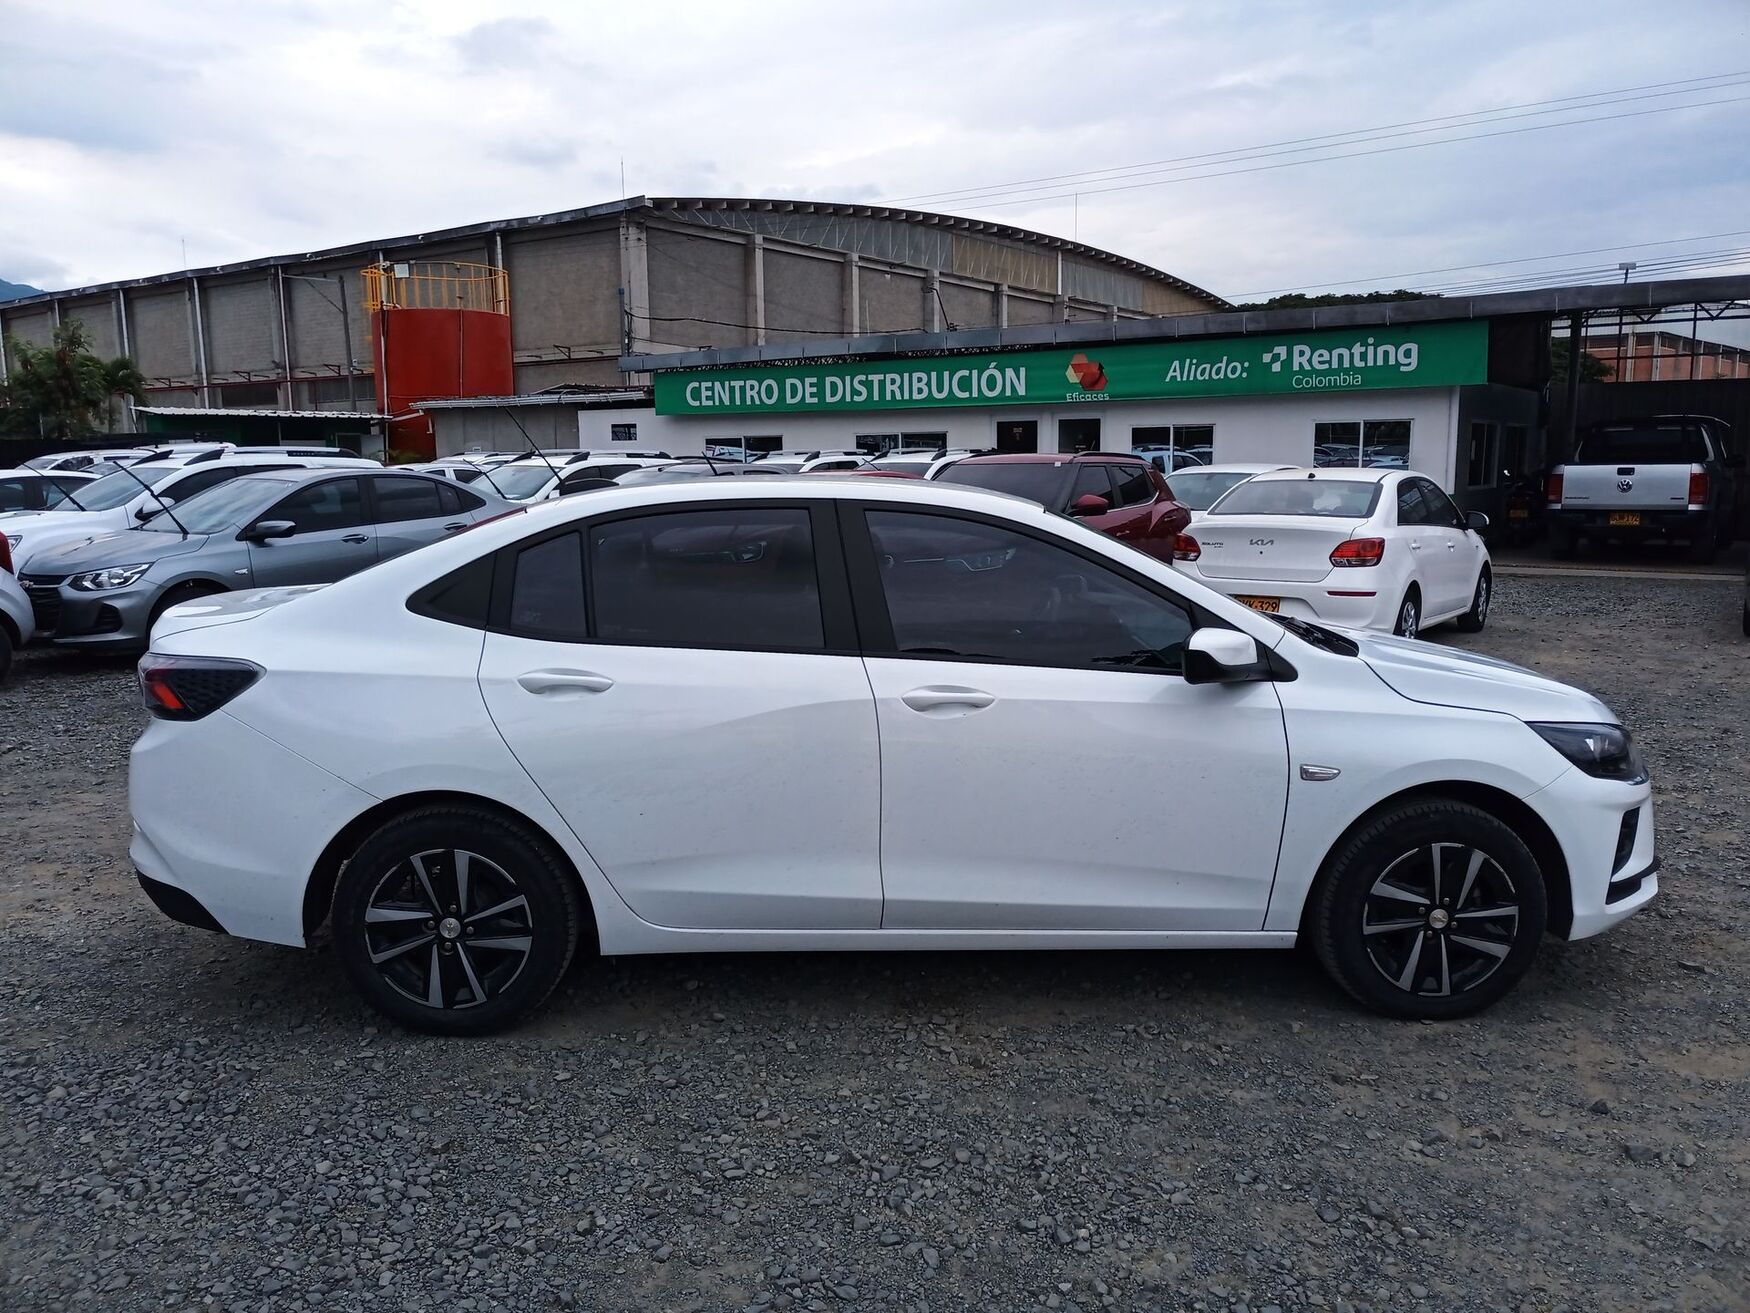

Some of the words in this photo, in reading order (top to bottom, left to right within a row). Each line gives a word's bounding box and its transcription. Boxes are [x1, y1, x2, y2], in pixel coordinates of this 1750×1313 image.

[1292, 337, 1419, 372] Renting
[1165, 356, 1250, 382] Aliado:
[1292, 371, 1362, 389] Colombia
[685, 378, 779, 407] CENTRO
[785, 377, 818, 404] DE
[825, 361, 1026, 403] DISTRIBUCIÓN
[1065, 391, 1110, 402] Eficaces
